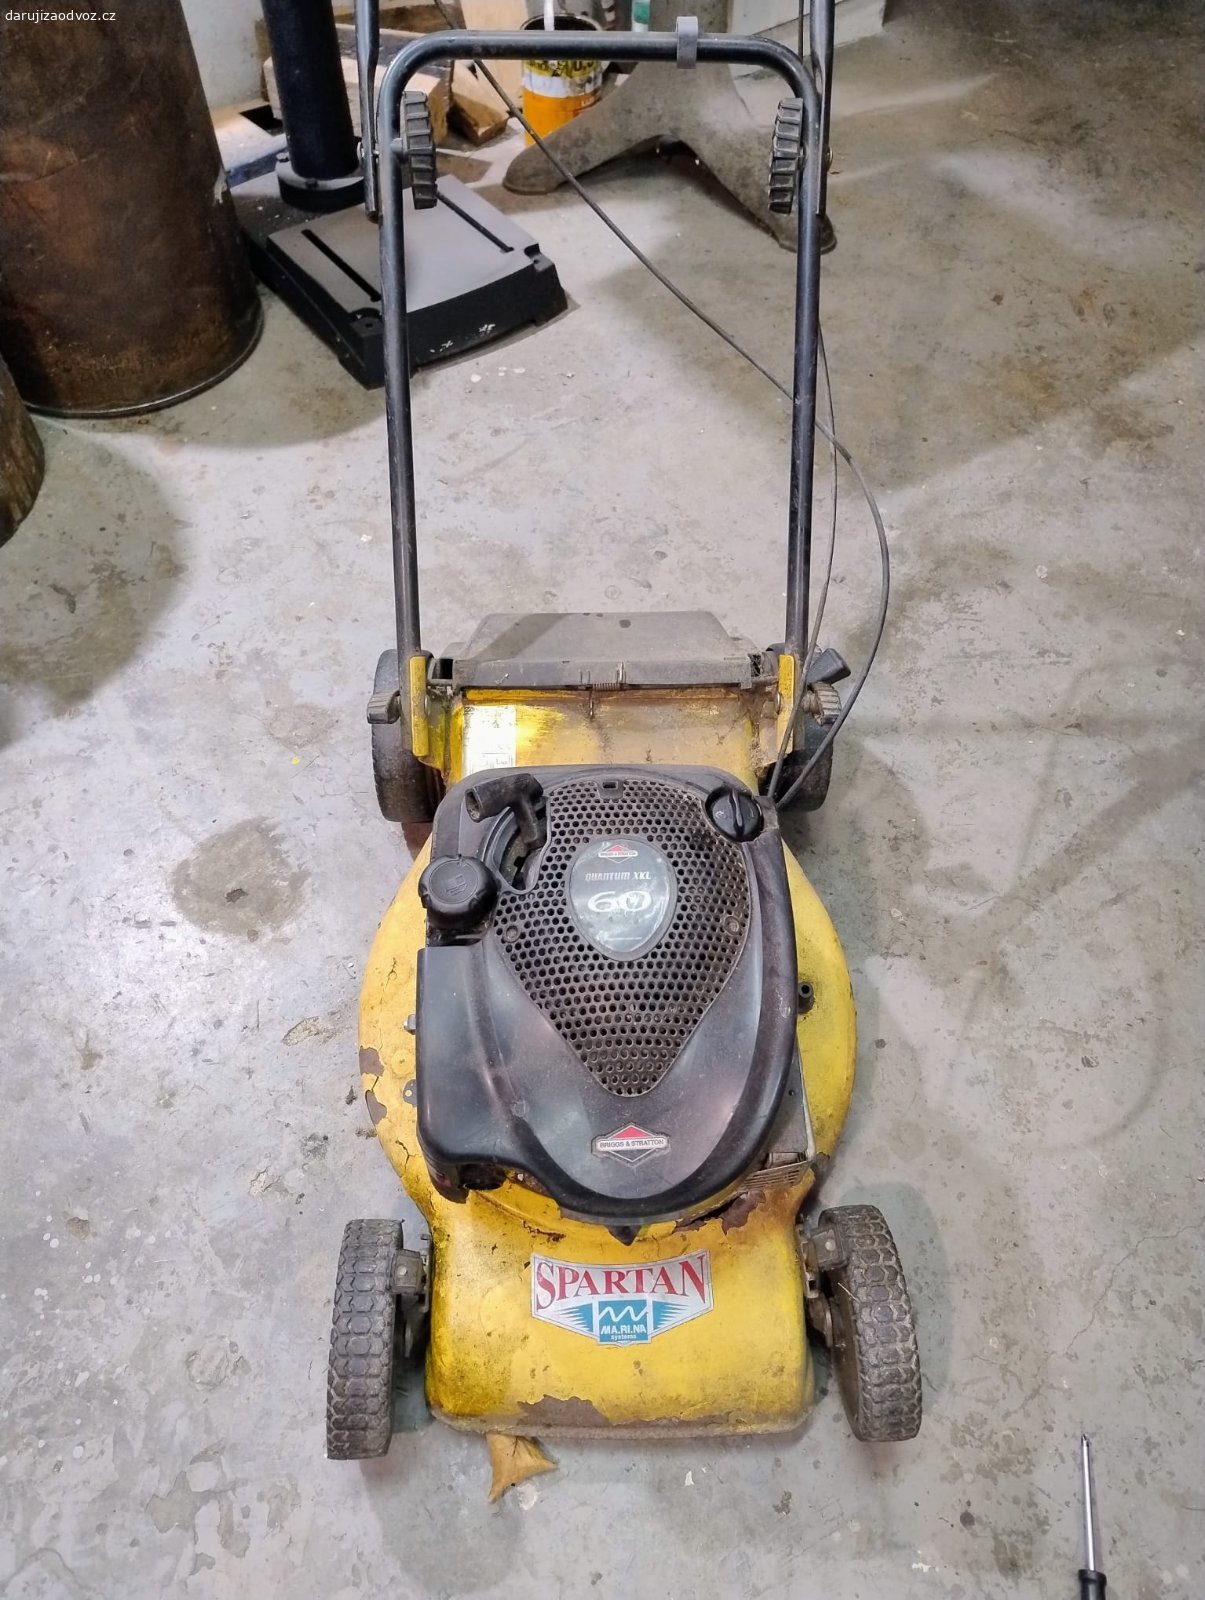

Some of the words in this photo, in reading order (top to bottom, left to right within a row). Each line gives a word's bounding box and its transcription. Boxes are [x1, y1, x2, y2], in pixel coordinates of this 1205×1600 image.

[585, 871, 631, 882] QUANTUM
[600, 1141, 625, 1149] BRIGGS
[631, 1139, 664, 1147] STRATTON
[536, 1254, 706, 1311] SPARTAN
[600, 1324, 647, 1335] MA.RI.NA
